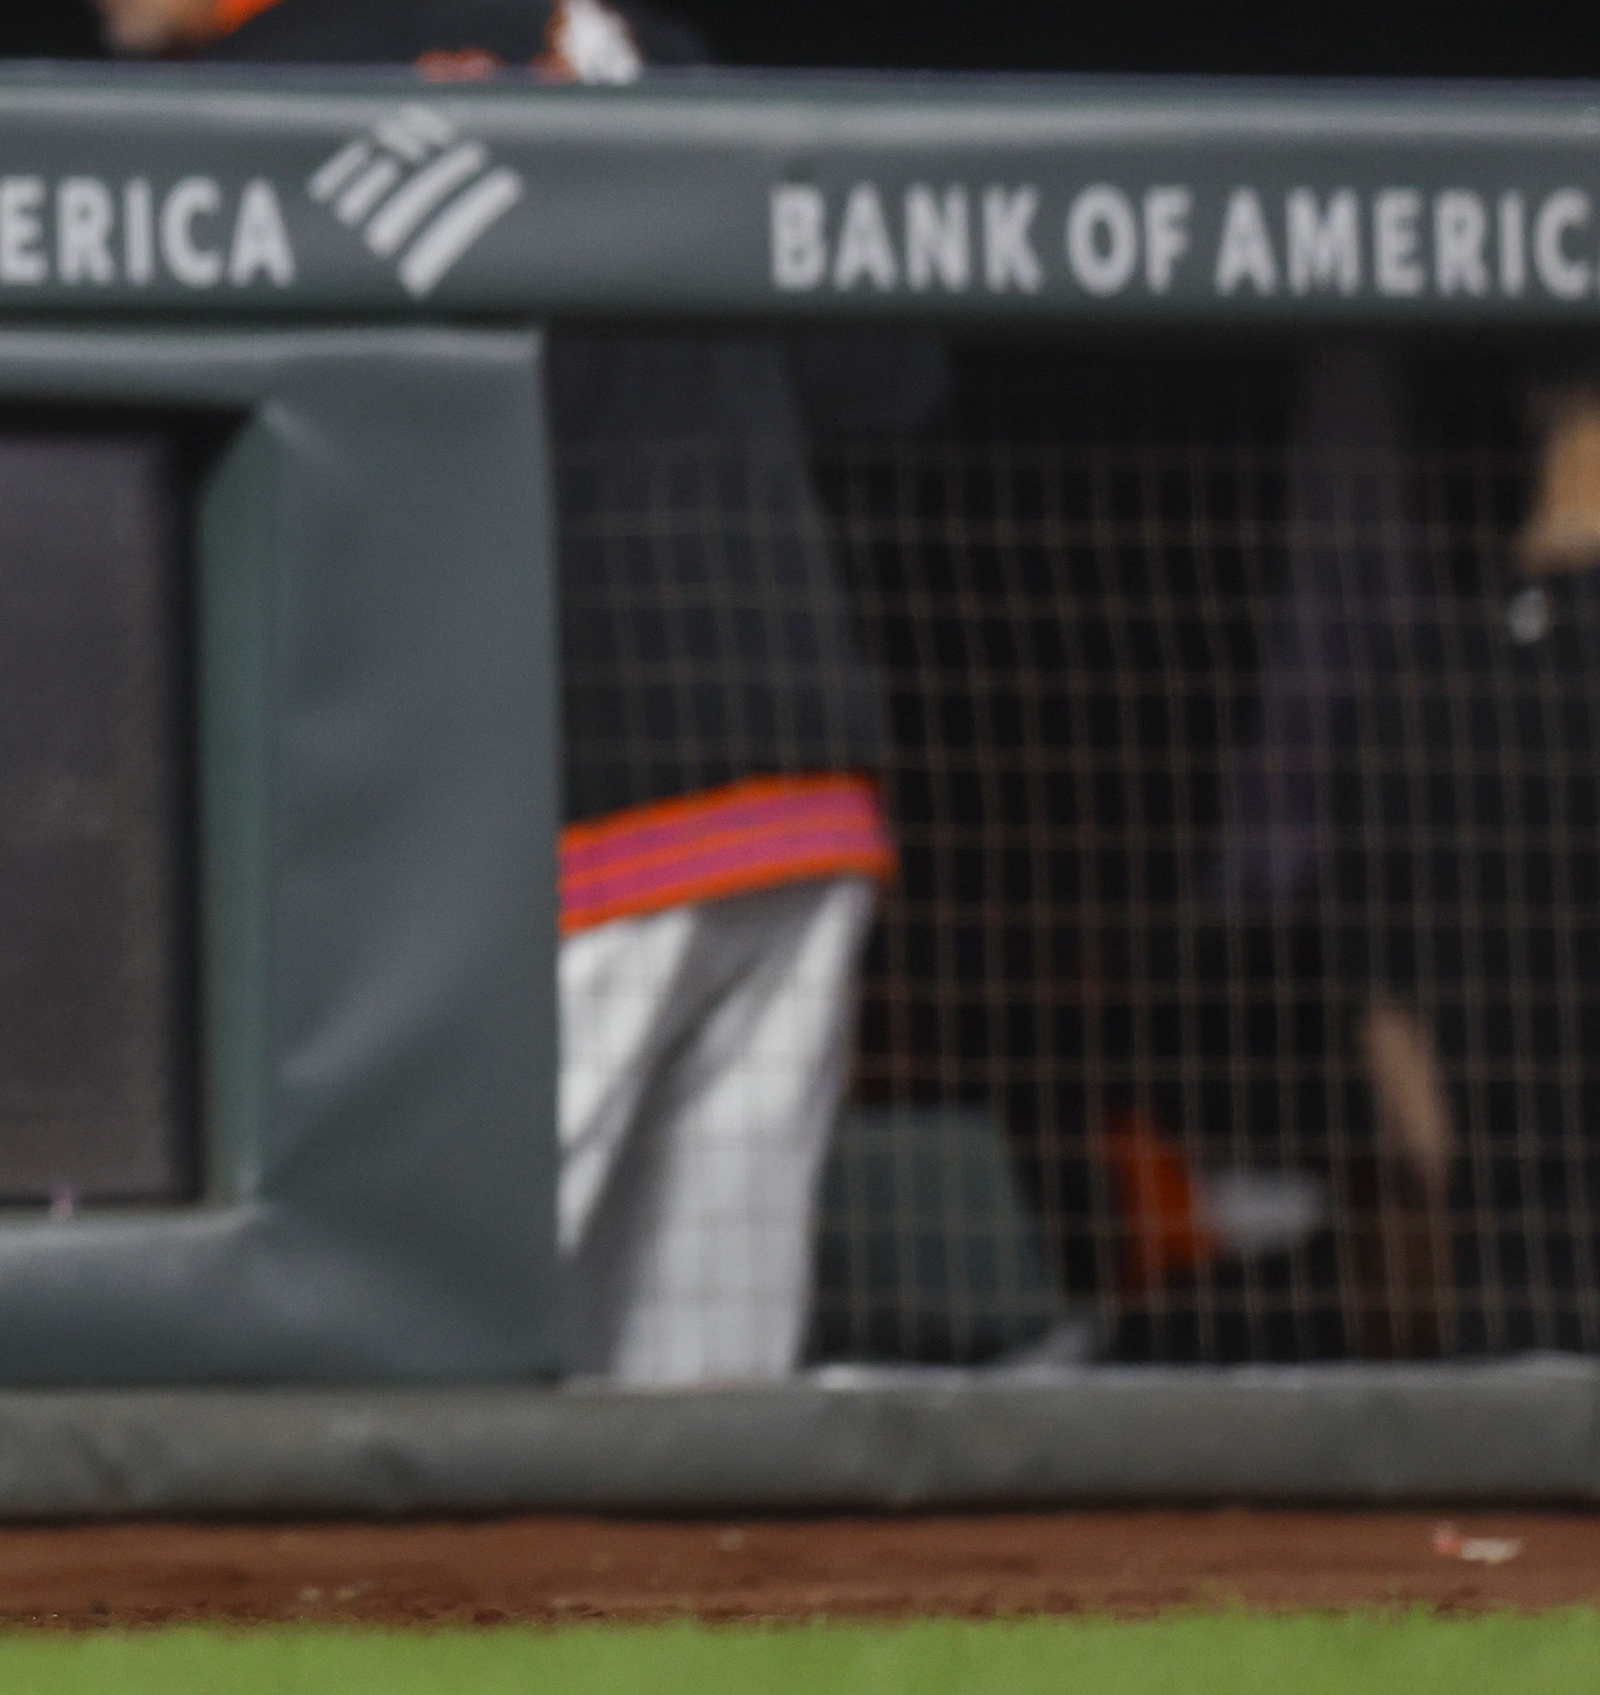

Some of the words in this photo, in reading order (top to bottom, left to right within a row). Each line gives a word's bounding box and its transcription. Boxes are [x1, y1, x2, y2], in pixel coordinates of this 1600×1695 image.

[768, 183, 1044, 295] BANK
[1066, 183, 1192, 297] OF
[1214, 185, 1600, 301] AMERIC
